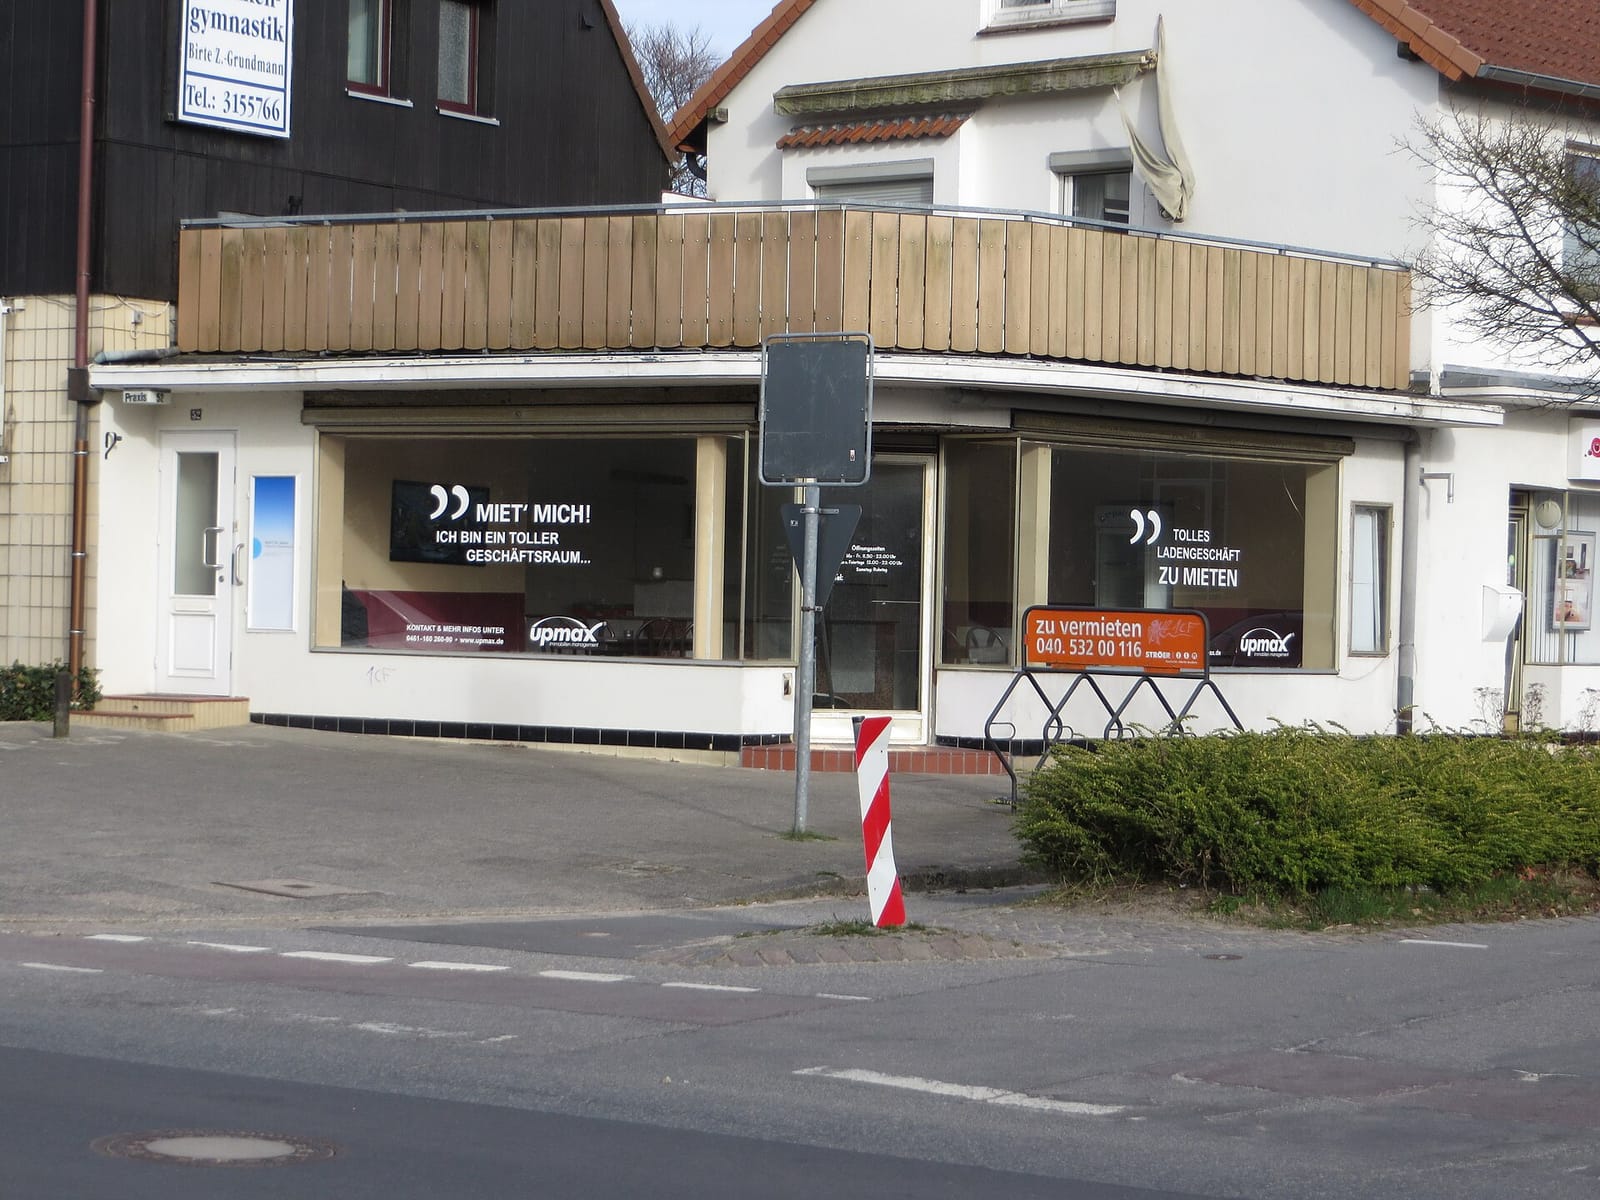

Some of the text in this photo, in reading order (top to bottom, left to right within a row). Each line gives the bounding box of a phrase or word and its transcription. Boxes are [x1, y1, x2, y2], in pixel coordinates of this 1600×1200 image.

[190, 7, 284, 42] gymnastik
[189, 42, 213, 62] Birte
[187, 84, 281, 121] Tel.: 3155766
[125, 392, 147, 402] Praxis
[533, 504, 591, 524] MICH!
[436, 530, 559, 545] ICH BIN EIN TOLLER
[1173, 528, 1210, 543] TOLLES
[466, 548, 591, 564] GESCHÄFTSRAUM...
[1157, 546, 1240, 562] LADENGESCHÄFT
[1158, 566, 1238, 587] ZU MIETEN
[482, 626, 505, 634] UNTER
[530, 620, 604, 646] upmax
[1036, 619, 1055, 635] zu
[1060, 616, 1142, 638] vermieten
[460, 637, 505, 645] www.upmax.de
[1036, 637, 1142, 657] 040. 532 00 116
[1240, 631, 1294, 657] upmax
